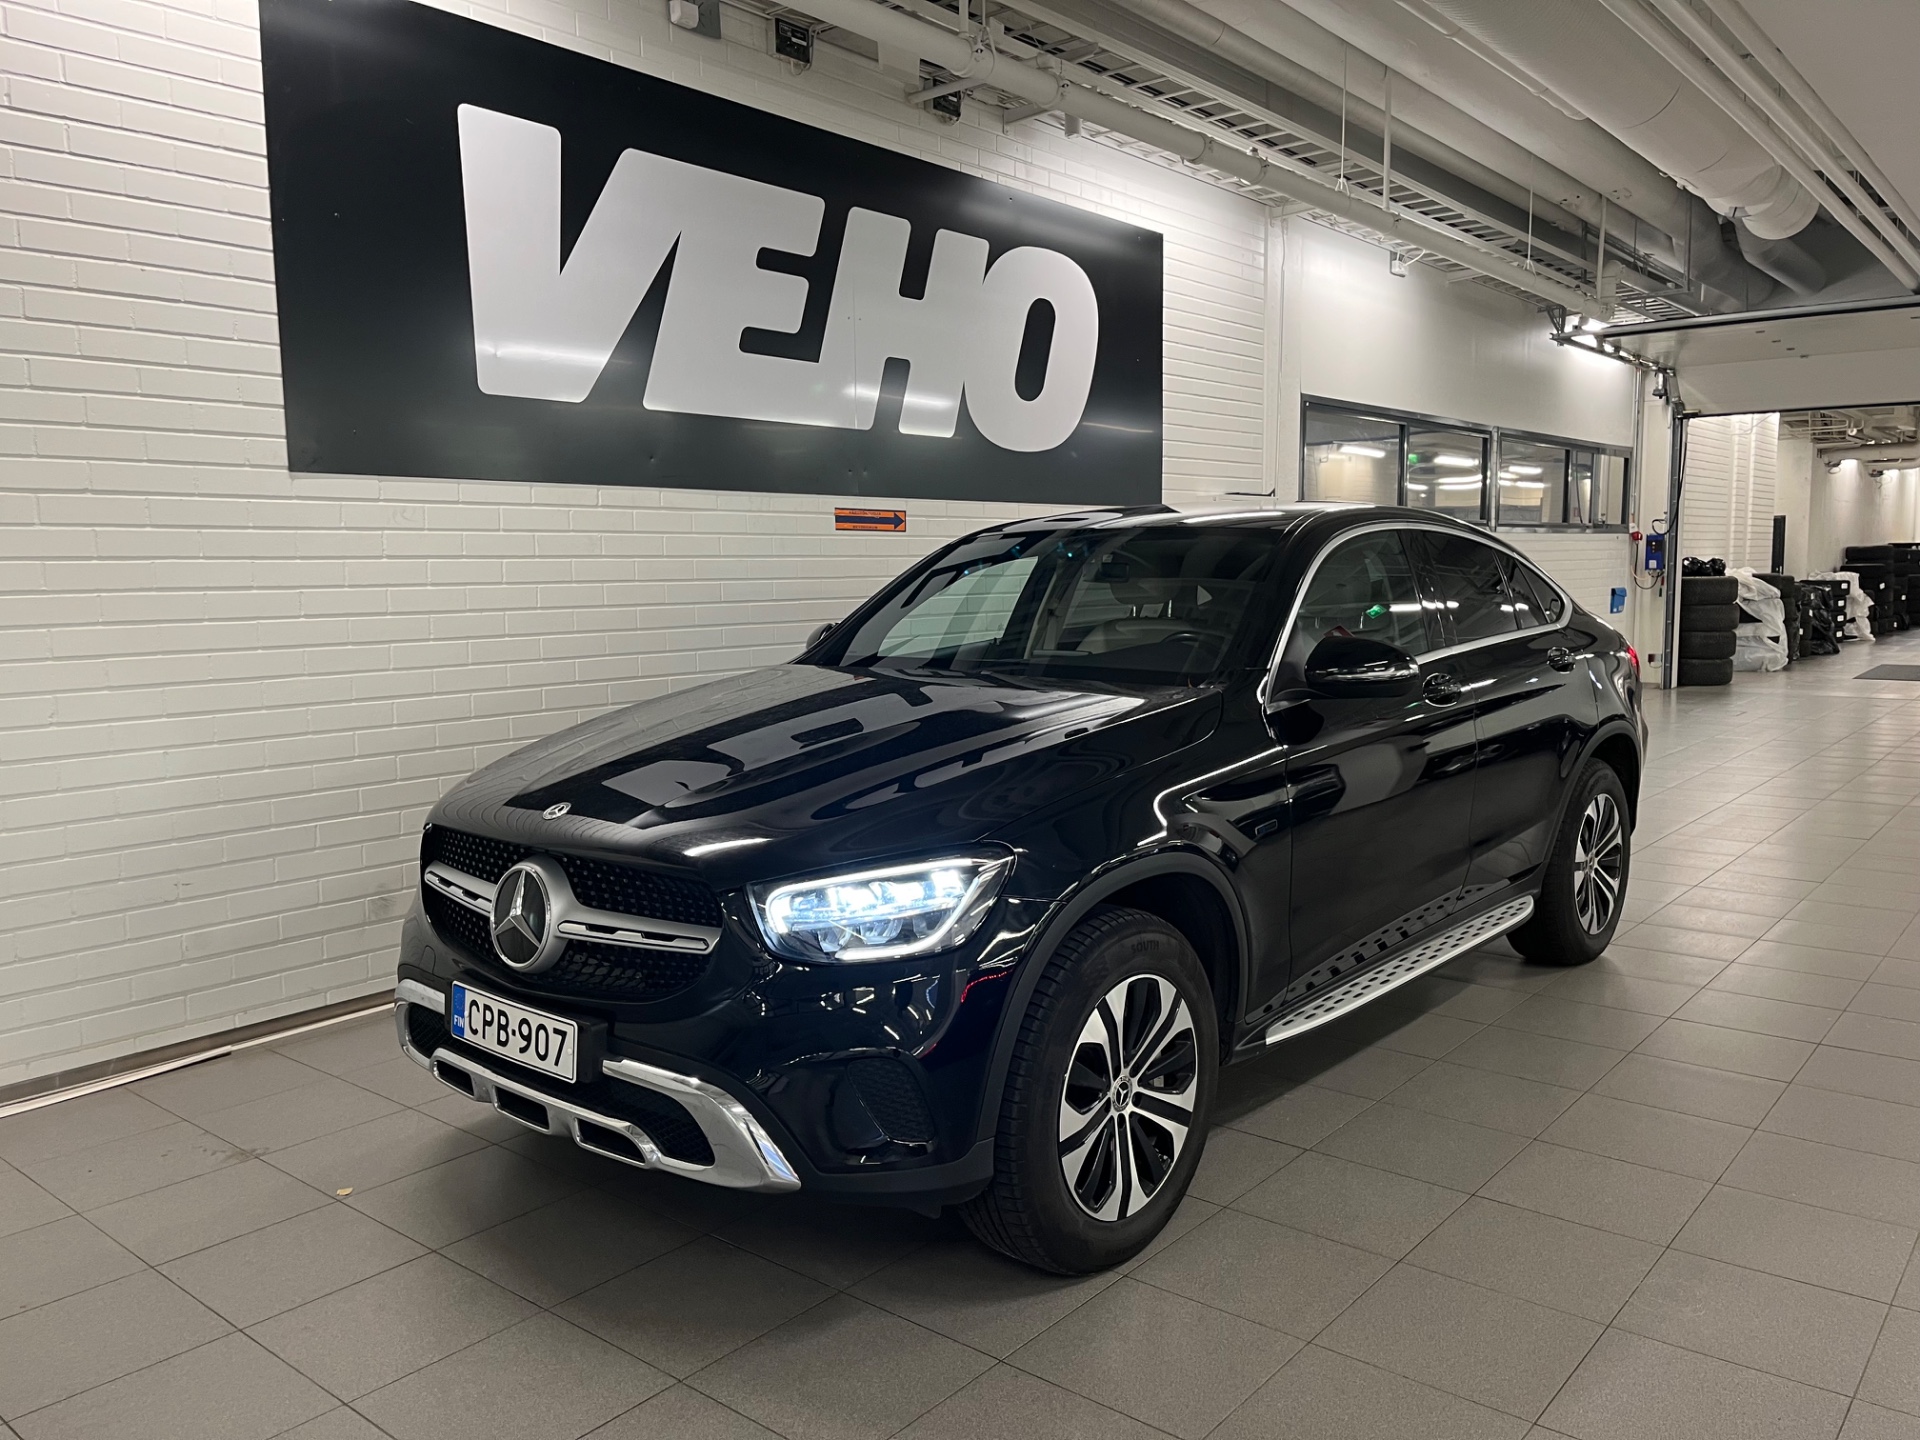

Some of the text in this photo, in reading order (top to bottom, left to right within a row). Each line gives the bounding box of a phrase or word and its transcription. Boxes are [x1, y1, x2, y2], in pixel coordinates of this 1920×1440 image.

[457, 103, 1099, 453] VEHO
[453, 1014, 465, 1028] FIN
[468, 999, 568, 1067] CPB-907
